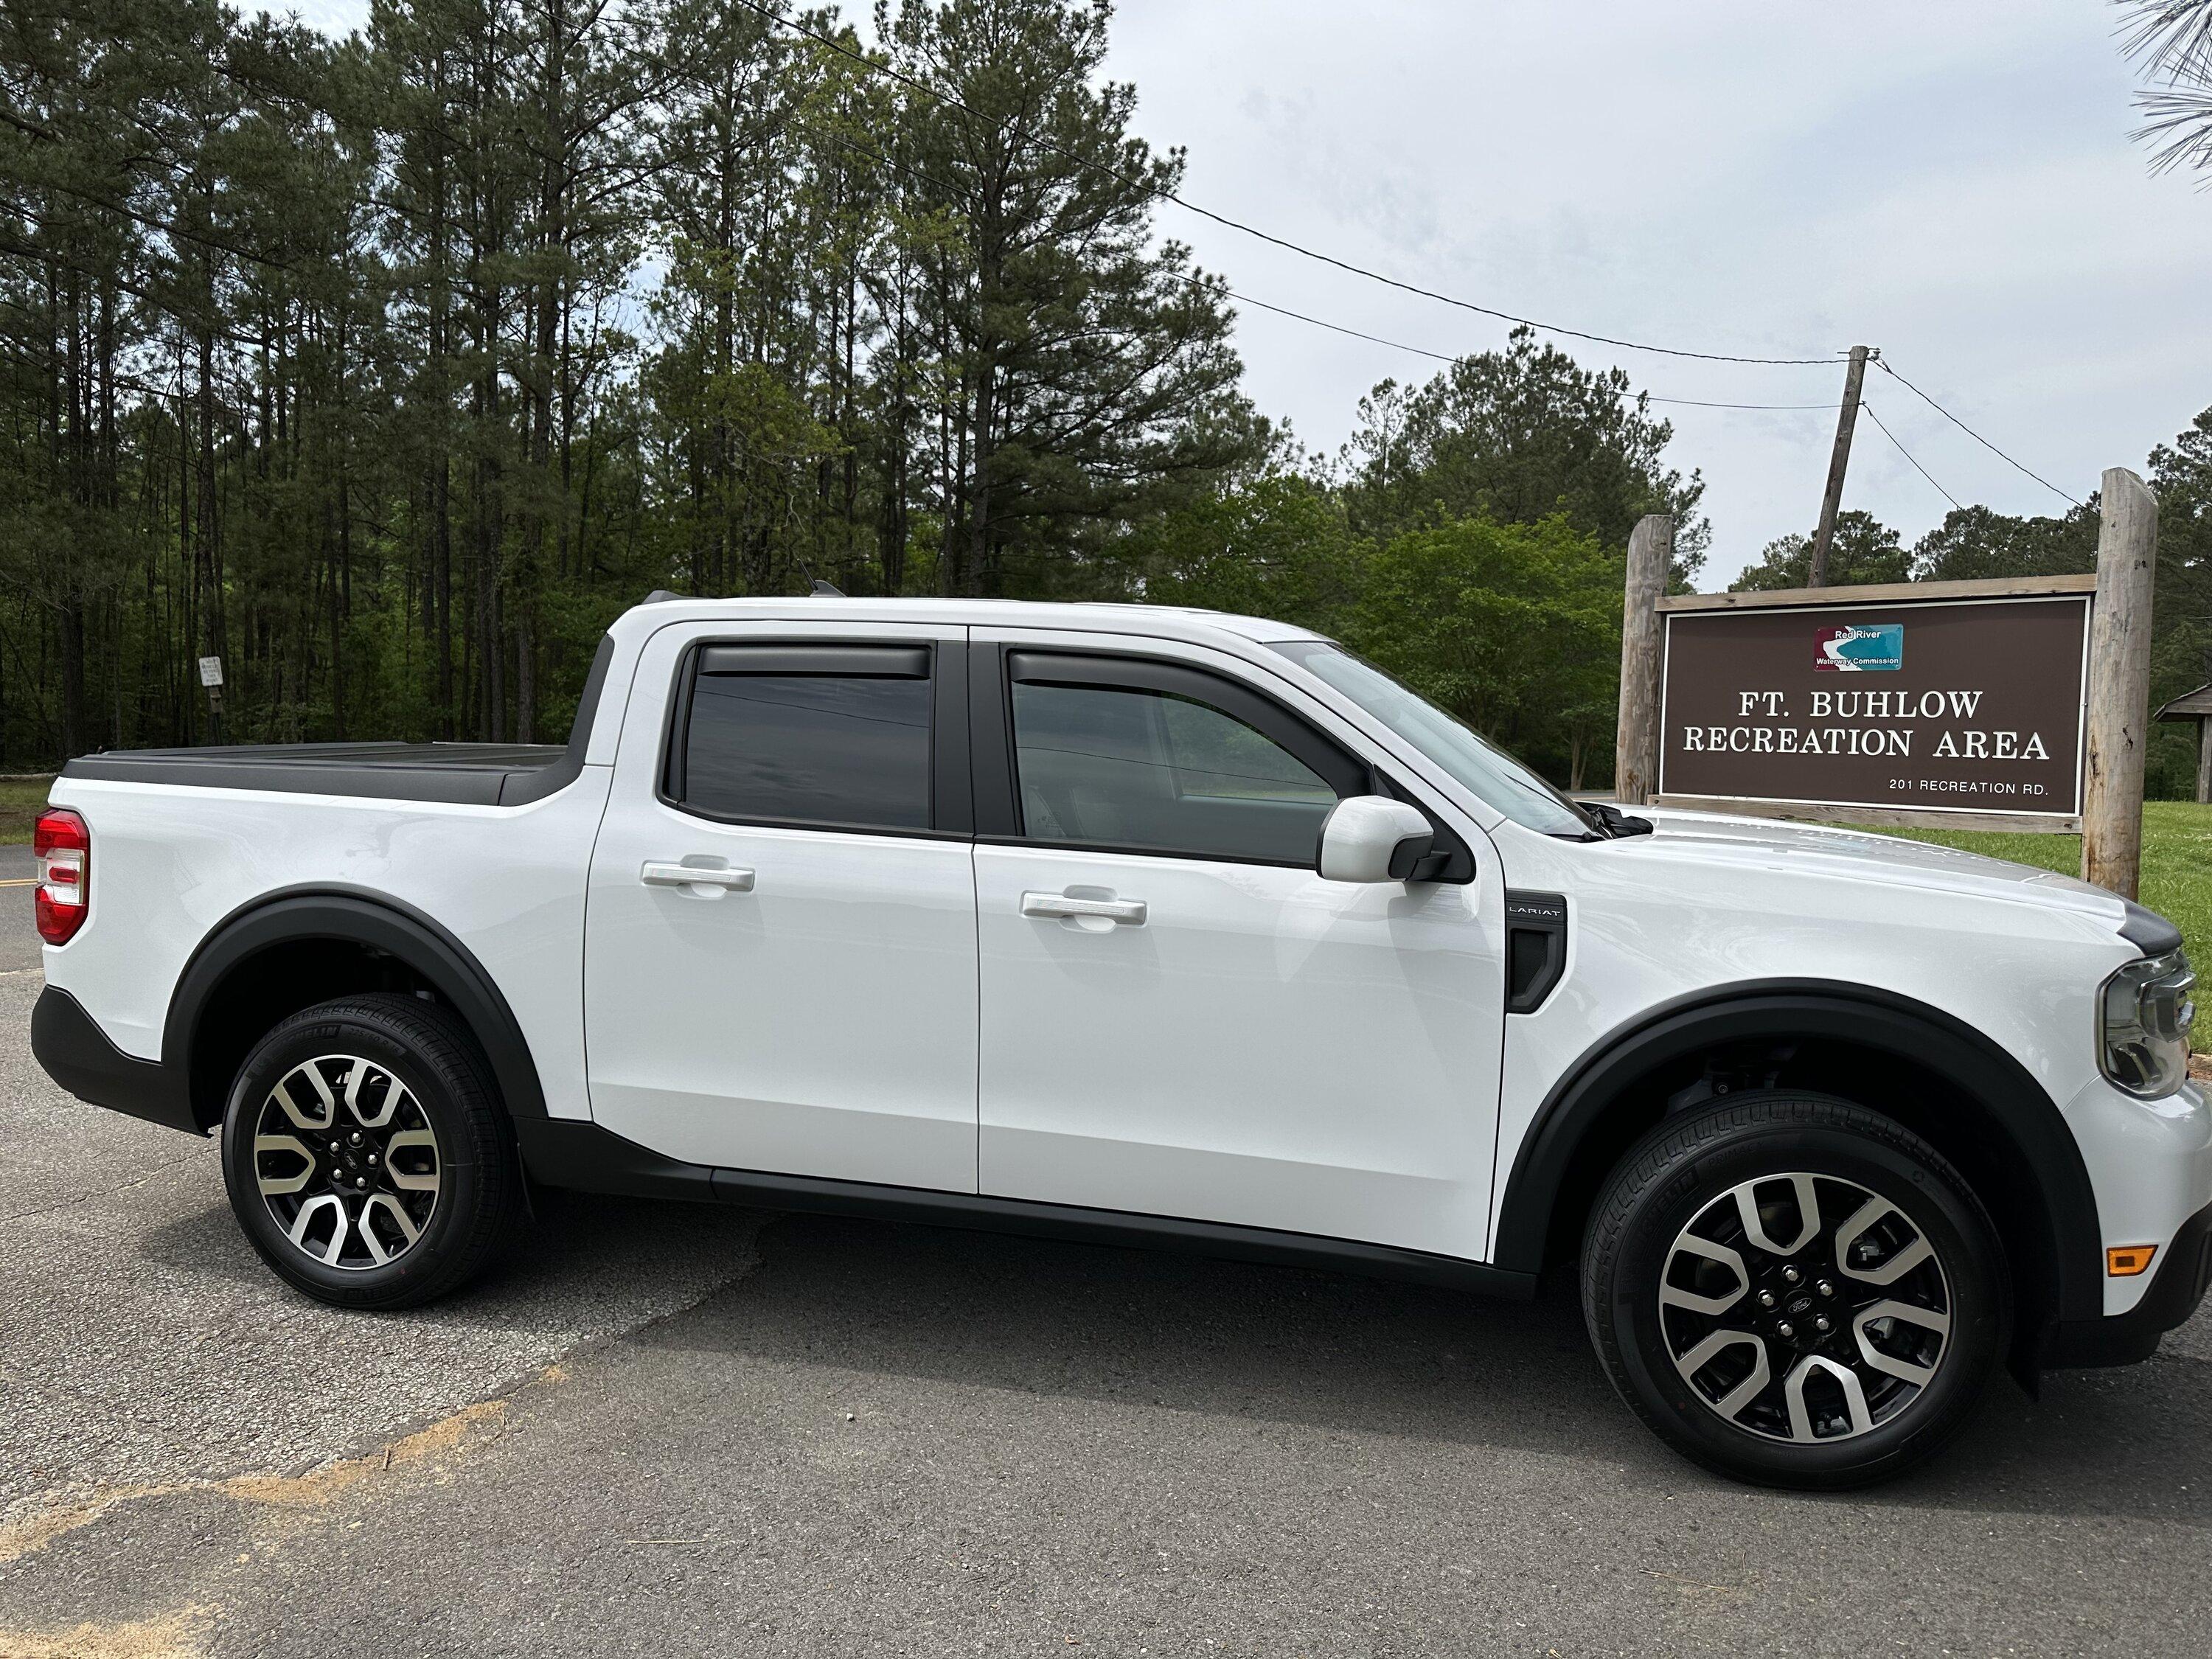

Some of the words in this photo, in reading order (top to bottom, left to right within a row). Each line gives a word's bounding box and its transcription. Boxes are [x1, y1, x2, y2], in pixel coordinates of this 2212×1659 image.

[1835, 630, 1854, 639] Red
[1856, 630, 1882, 639] River
[1815, 658, 1852, 667] Waterway
[1852, 658, 1899, 666] Commission
[1737, 691, 1790, 717] FT.
[1809, 690, 1983, 719] BUHLOW
[1683, 726, 1914, 757] RECREATION
[1932, 730, 2050, 760] AREA
[1889, 779, 1913, 790] 201
[1919, 779, 2016, 795] RECREATION
[2022, 783, 2049, 796] RD.
[1509, 906, 1561, 917] LARIAT
